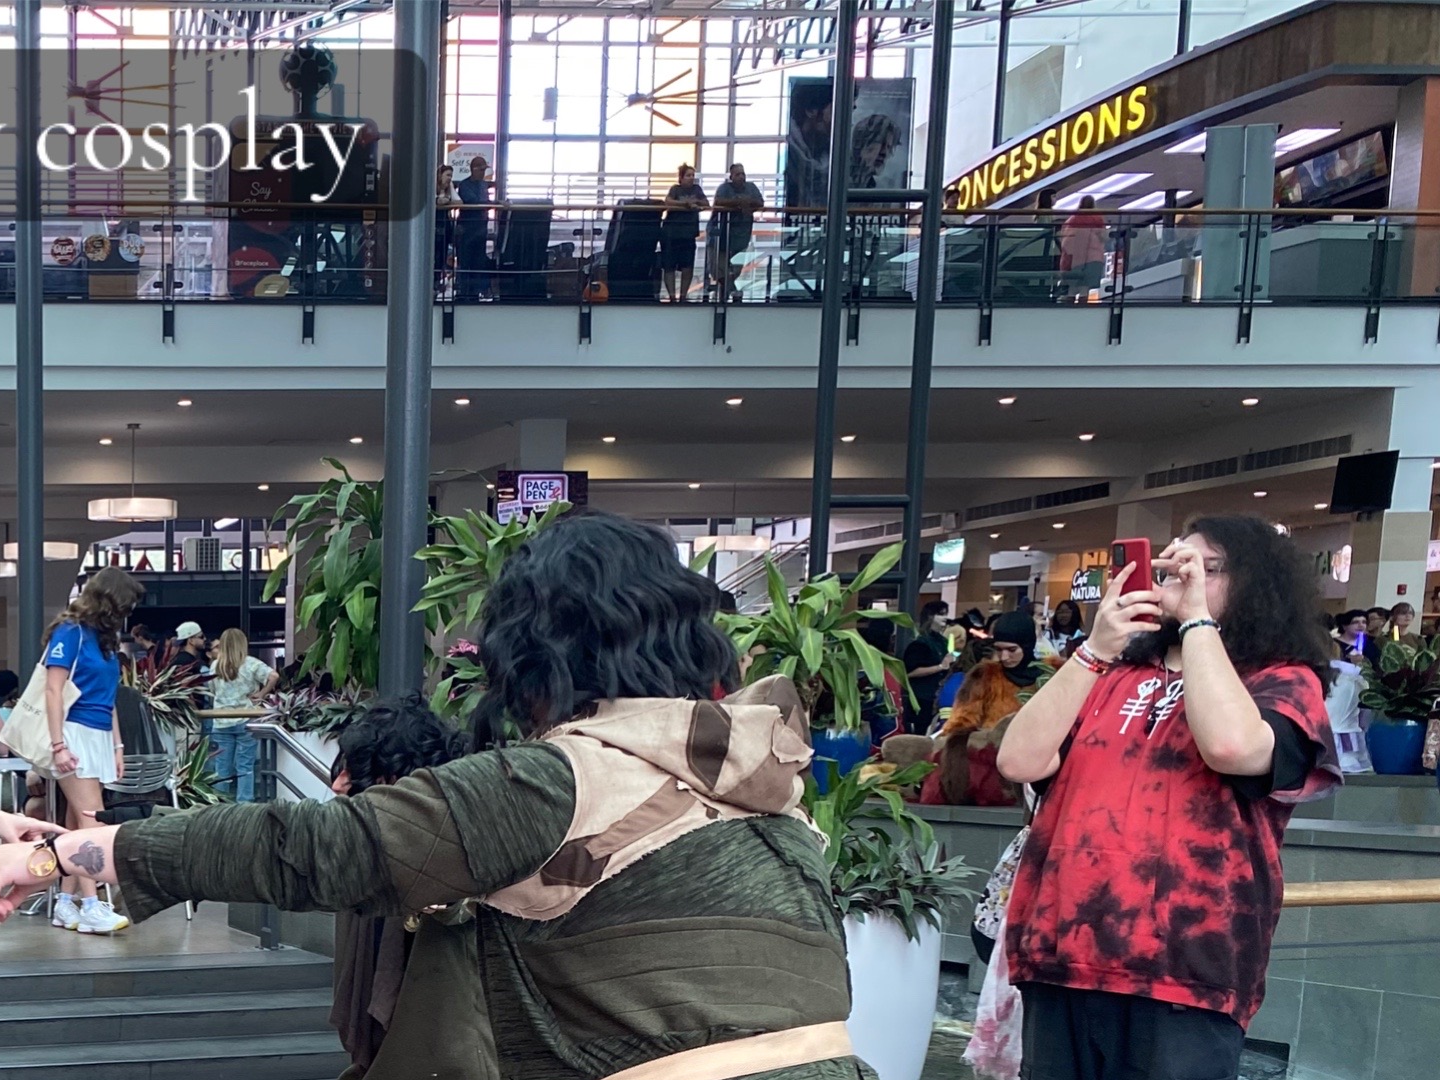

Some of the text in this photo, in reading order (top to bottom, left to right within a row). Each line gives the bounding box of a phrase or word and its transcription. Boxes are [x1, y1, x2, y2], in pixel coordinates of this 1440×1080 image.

[250, 181, 272, 200] Say
[526, 481, 554, 491] PAGE
[526, 490, 547, 500] PEN
[1070, 586, 1101, 601] NATURA
